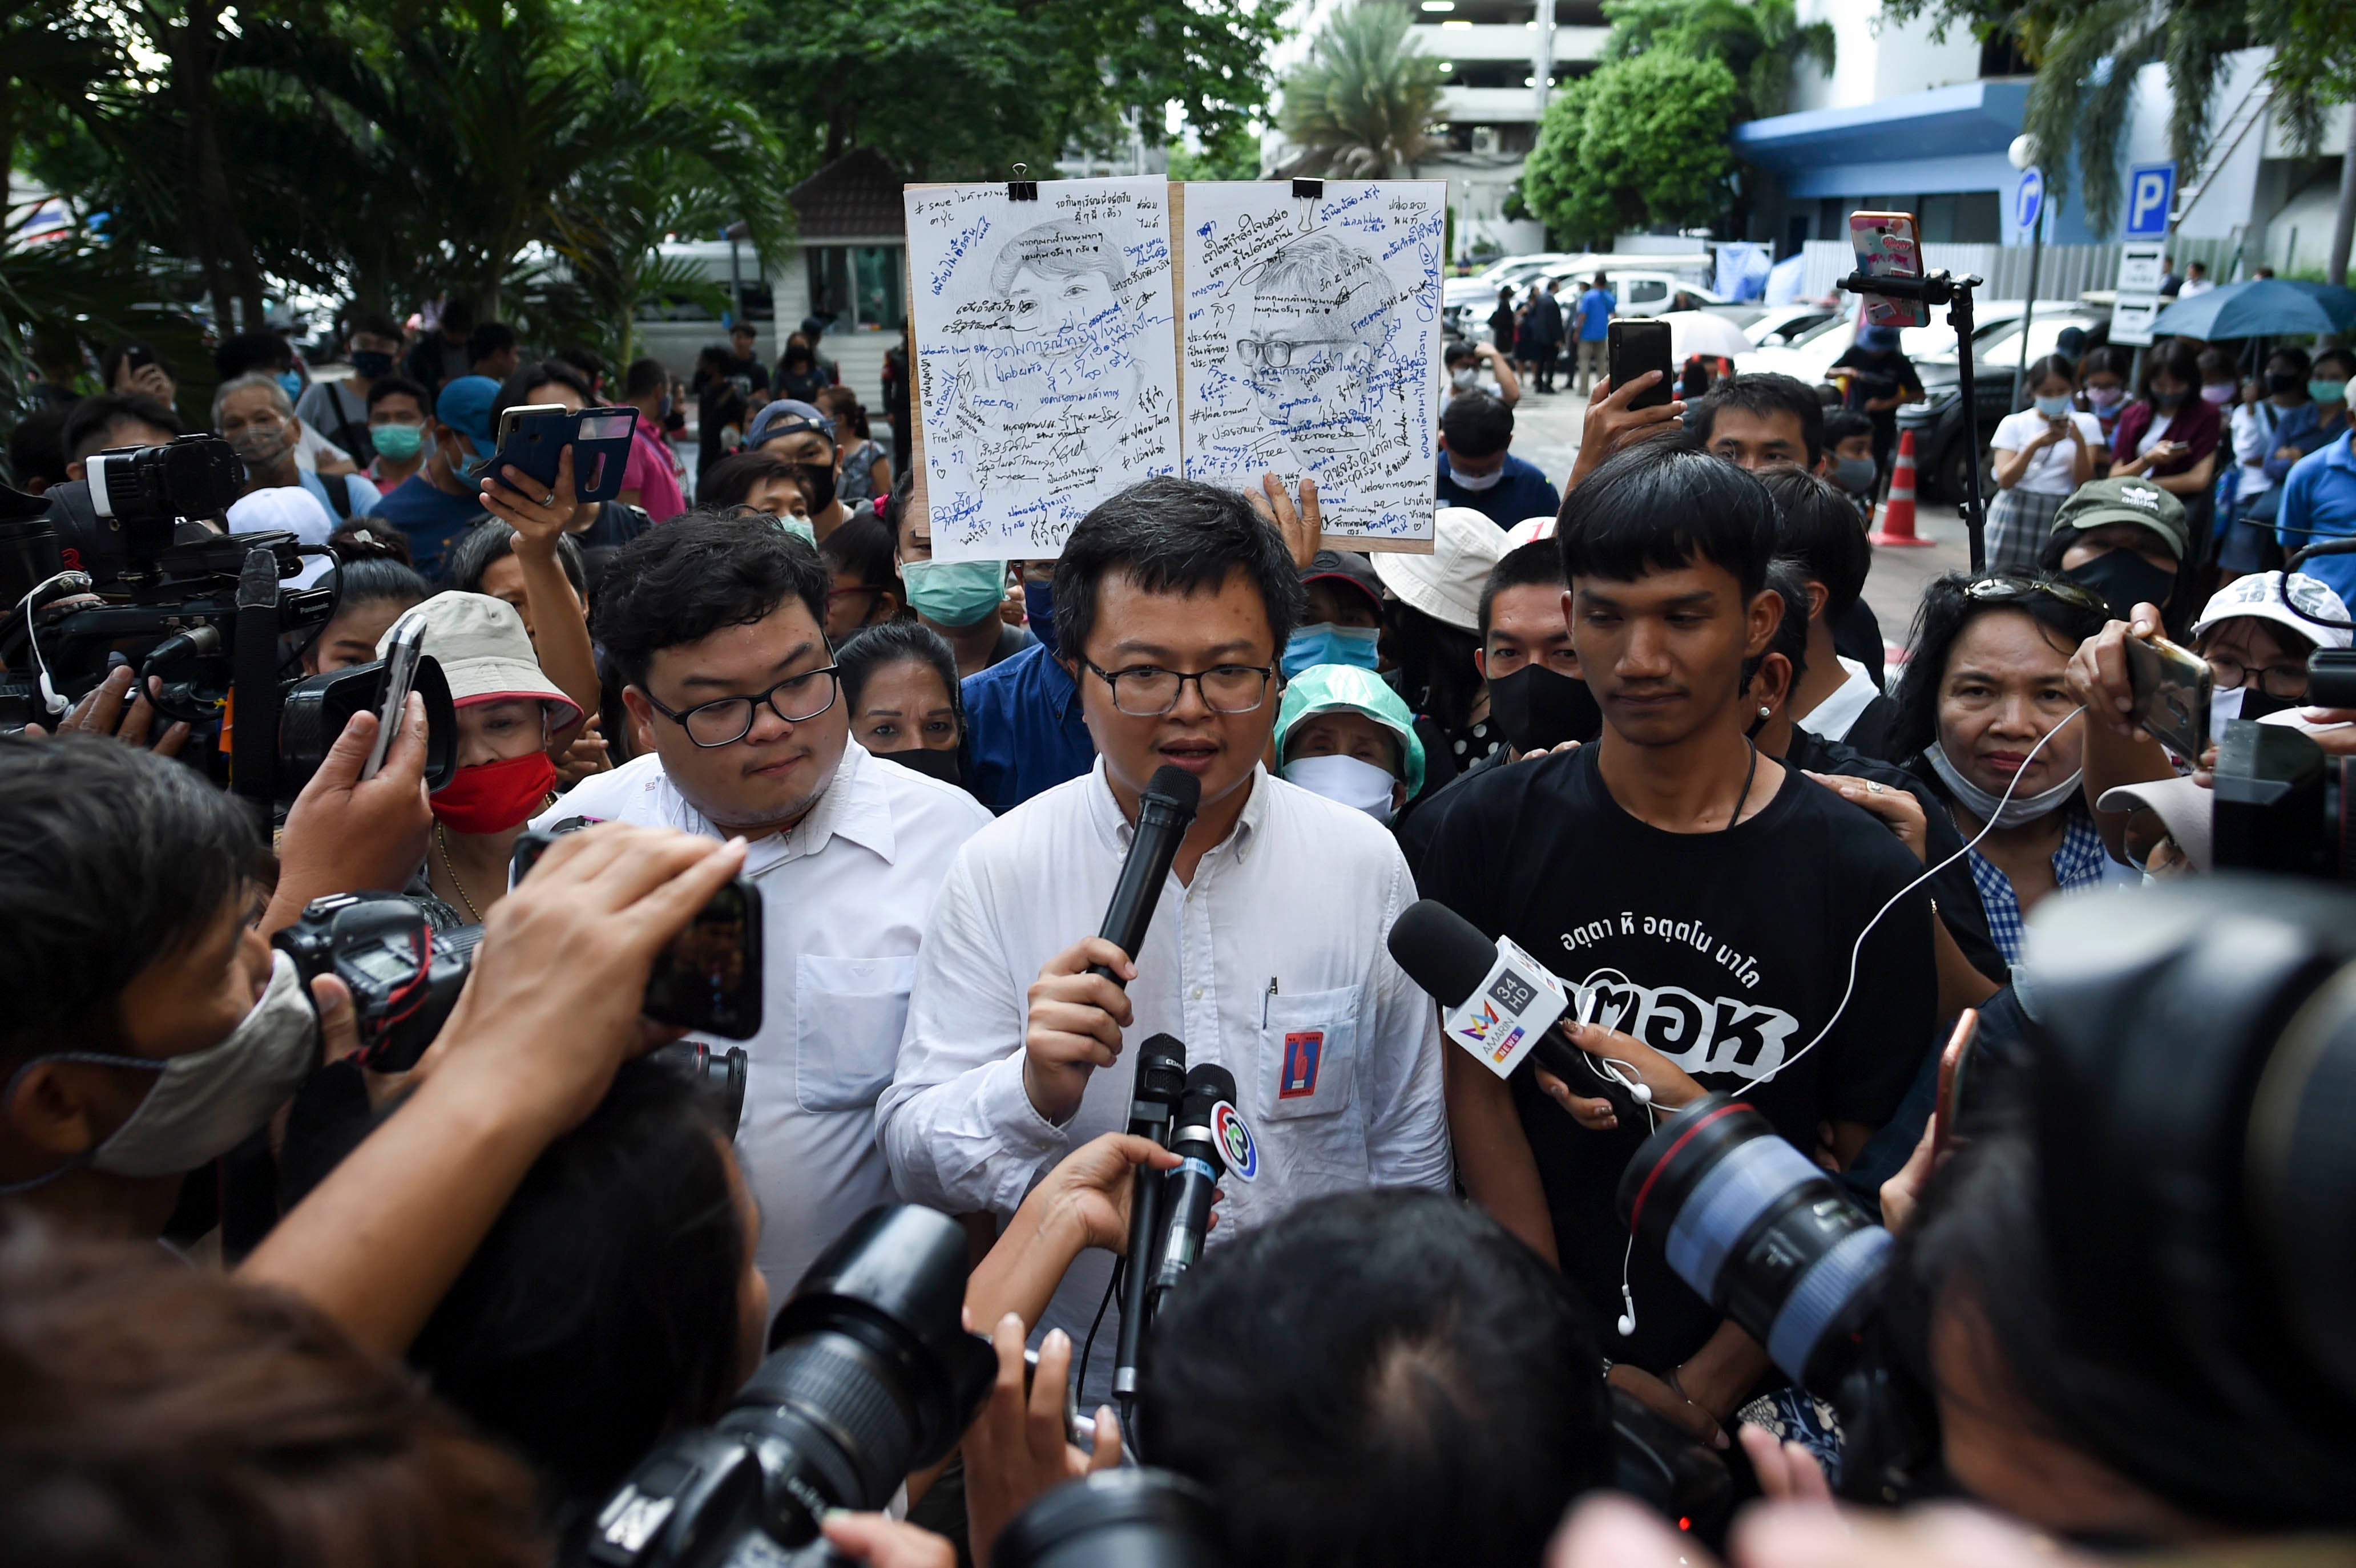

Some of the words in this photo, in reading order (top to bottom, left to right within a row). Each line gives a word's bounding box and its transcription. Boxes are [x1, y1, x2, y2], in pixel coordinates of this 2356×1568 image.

[929, 200, 953, 211] save
[2132, 173, 2165, 229] P
[2121, 496, 2159, 511] adidas
[1496, 977, 1518, 1000] 34
[1508, 987, 1530, 1009] HD
[1482, 1017, 1515, 1055] AMARIN
[1498, 1032, 1520, 1057] NEWS
